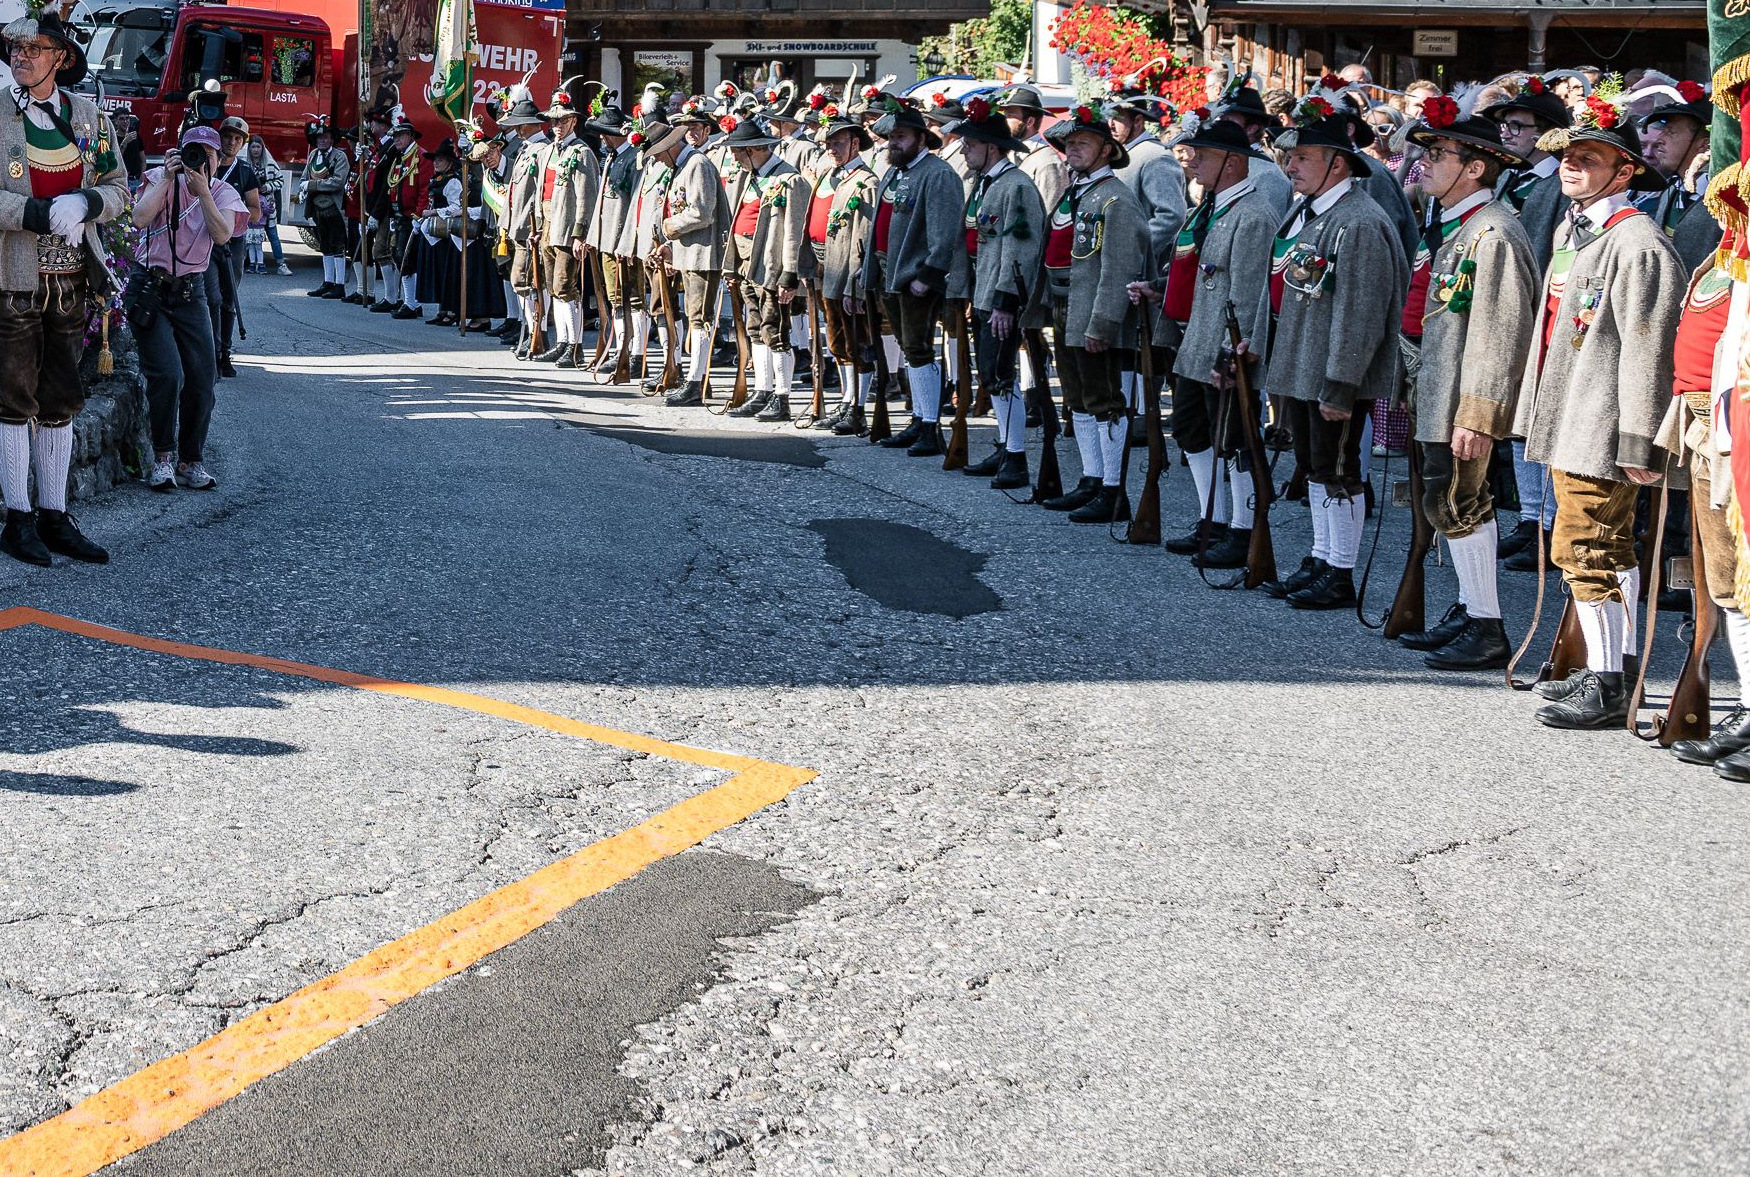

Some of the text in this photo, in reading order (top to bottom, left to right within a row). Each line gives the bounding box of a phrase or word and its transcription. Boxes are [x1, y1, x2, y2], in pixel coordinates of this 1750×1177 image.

[1418, 34, 1452, 42] Zimmer
[783, 42, 877, 52] SNOWBOARDSCHULE
[1428, 44, 1443, 52] frei
[270, 92, 298, 104] LASTA
